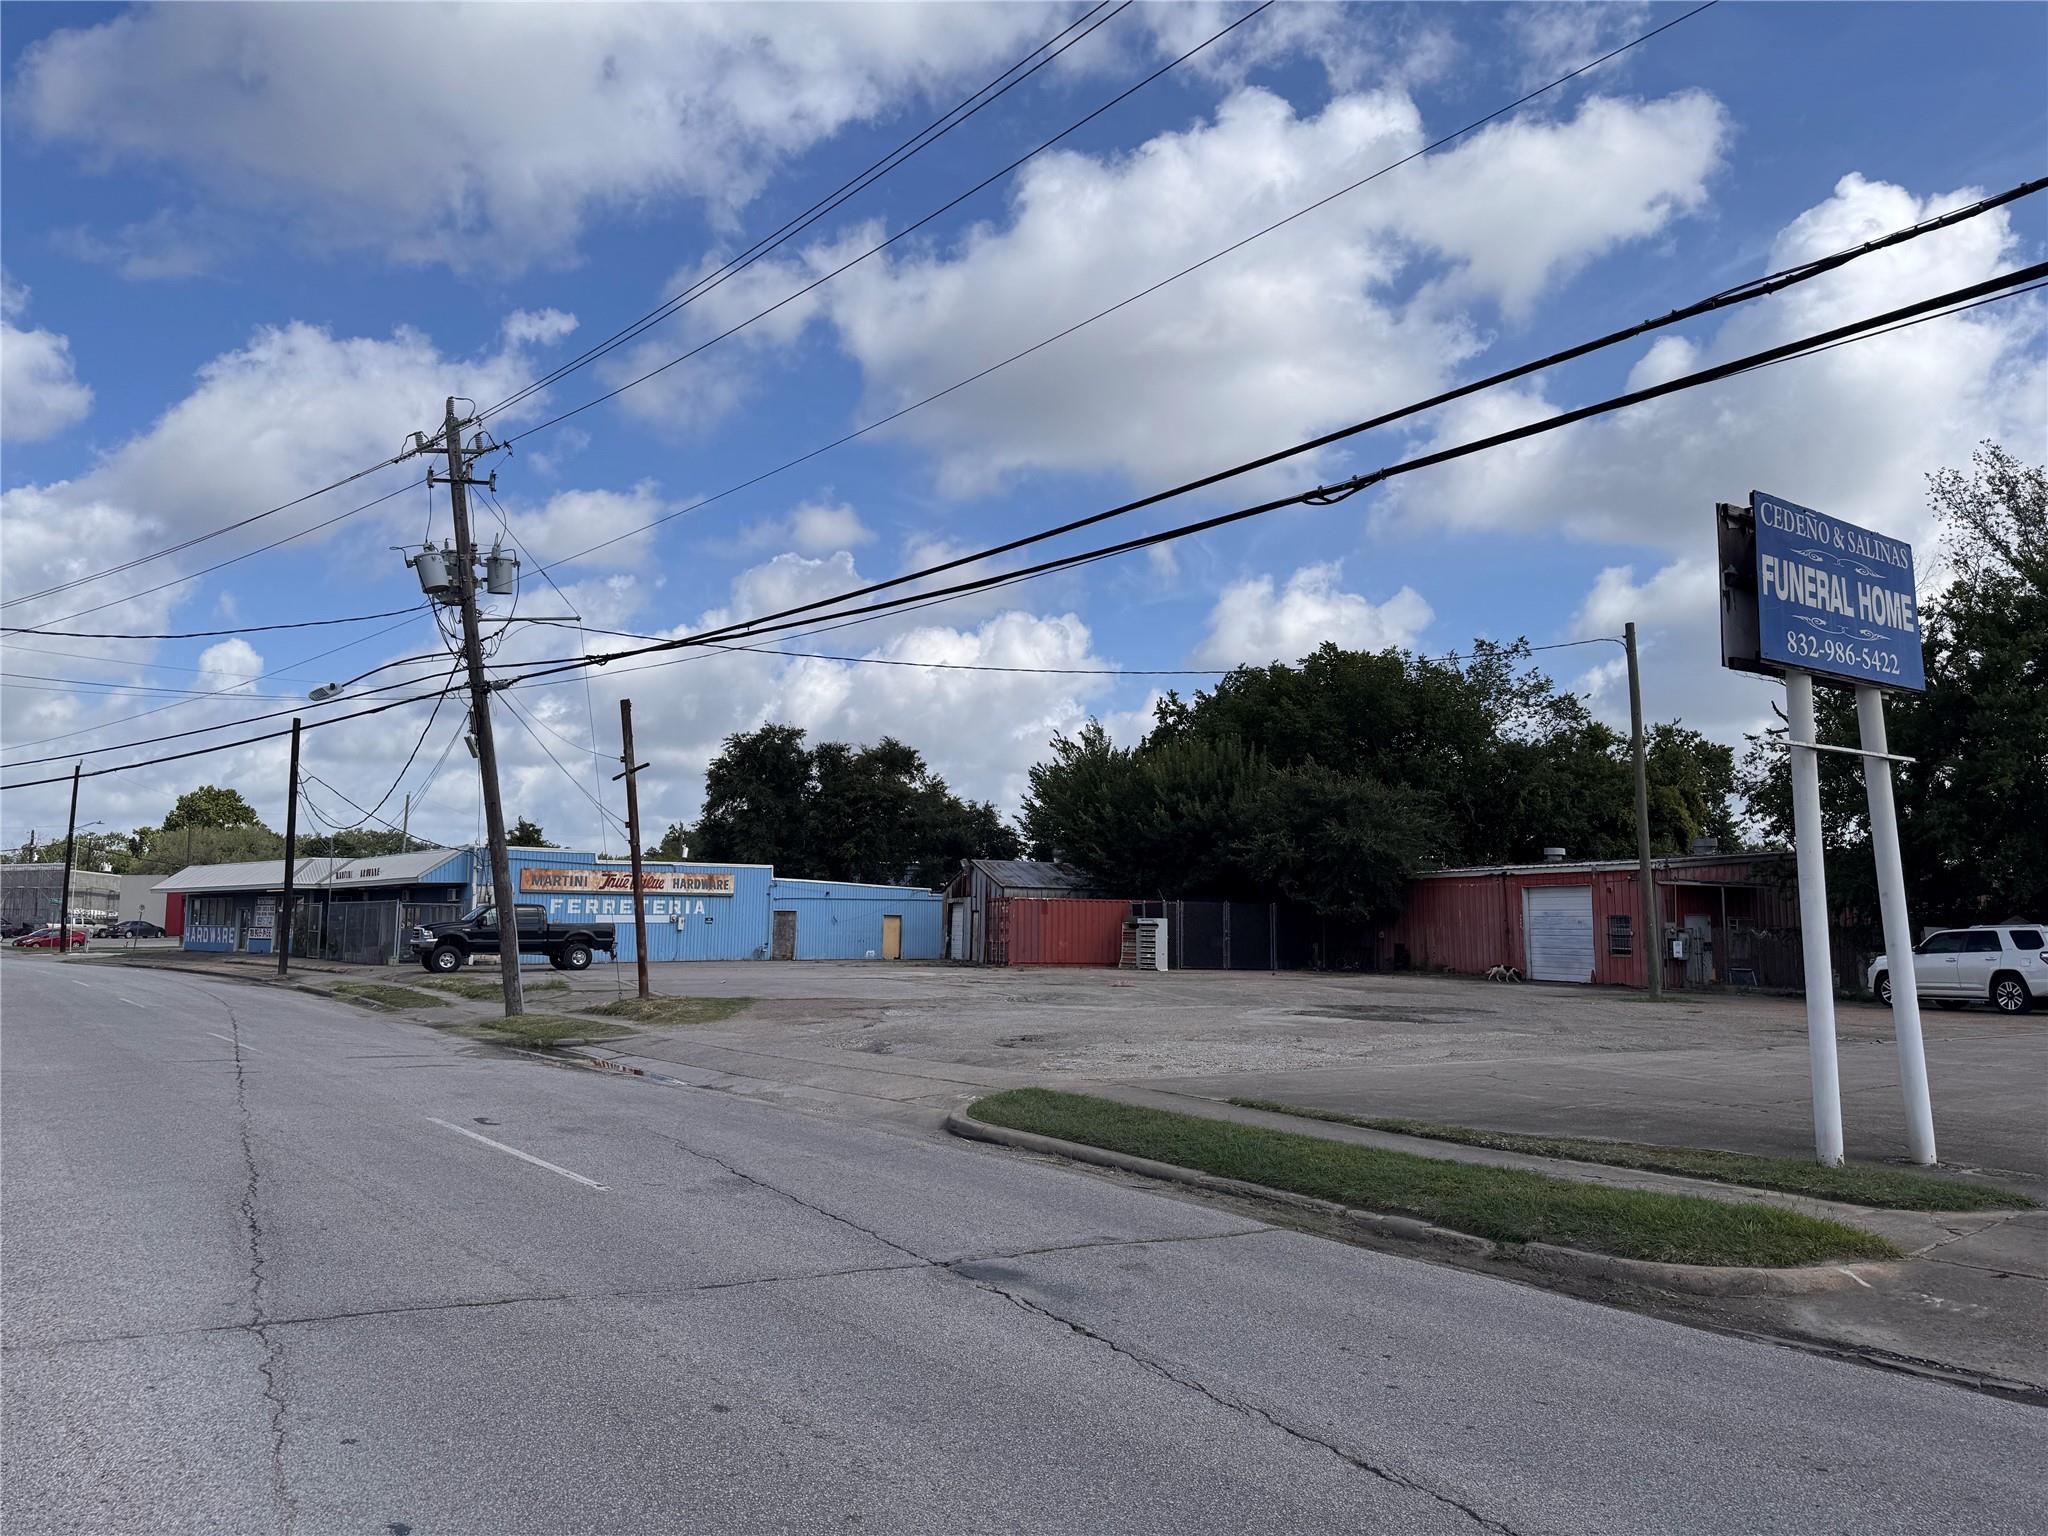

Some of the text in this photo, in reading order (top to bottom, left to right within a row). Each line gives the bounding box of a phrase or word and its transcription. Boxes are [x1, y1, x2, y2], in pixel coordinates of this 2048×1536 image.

[1760, 502, 1908, 569] CEDEÑO & SALINAS
[1761, 553, 1915, 633] FUNERAL HOME
[1786, 630, 1901, 675] 832-986-5422
[531, 873, 588, 888] MARTINI
[598, 872, 630, 890] True
[672, 875, 730, 892] HARDWARE
[185, 927, 235, 943] HARDWARE
